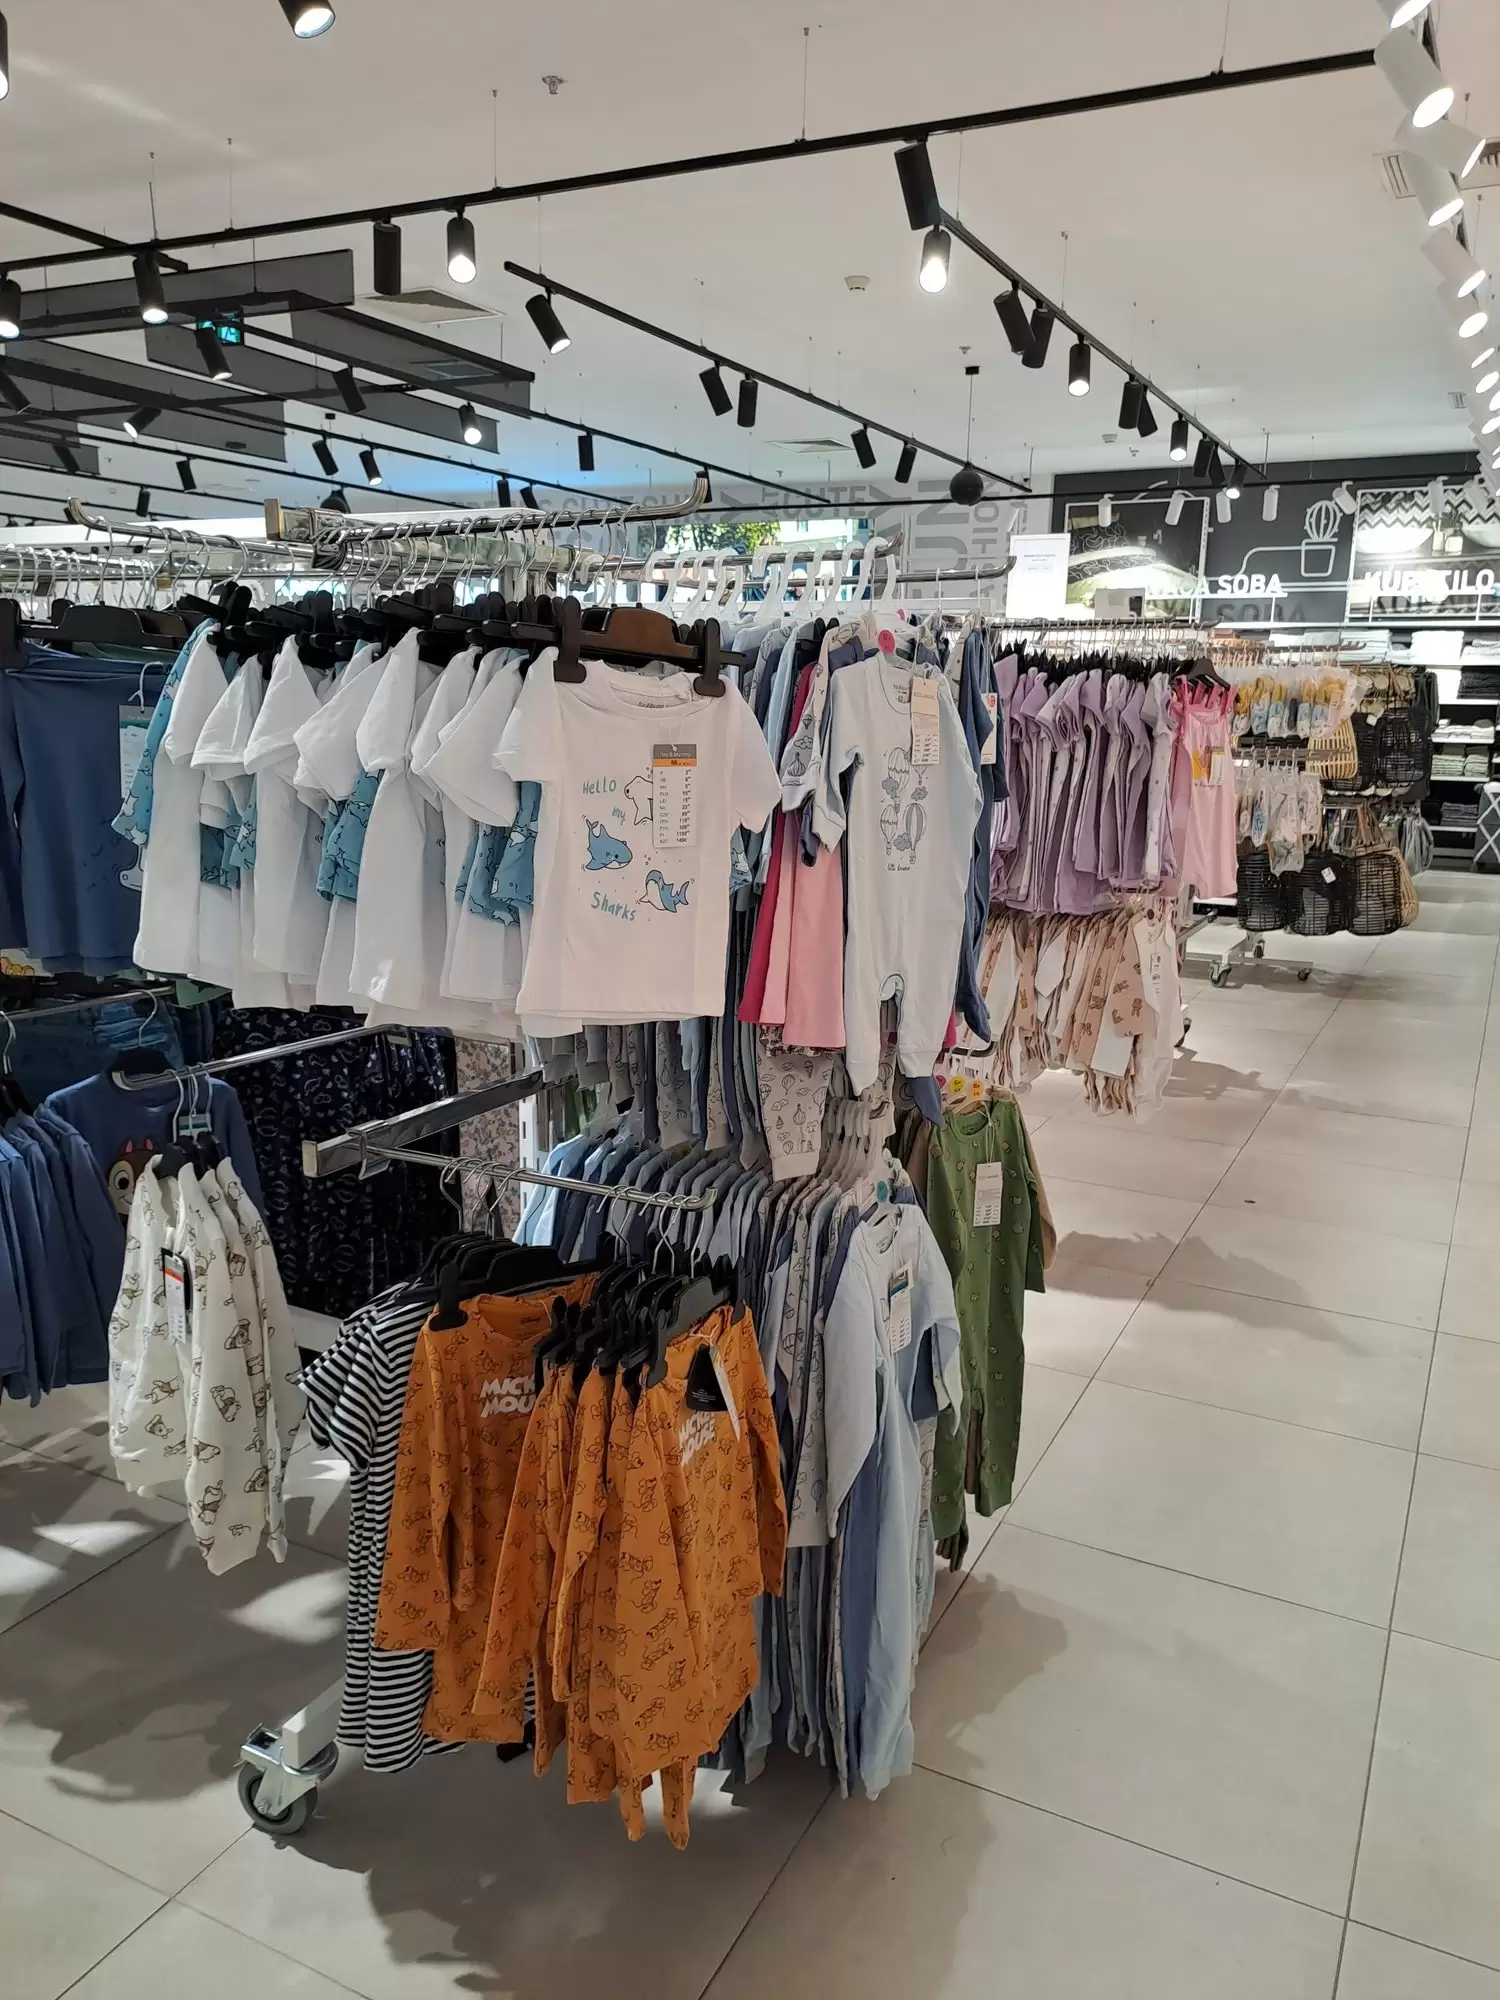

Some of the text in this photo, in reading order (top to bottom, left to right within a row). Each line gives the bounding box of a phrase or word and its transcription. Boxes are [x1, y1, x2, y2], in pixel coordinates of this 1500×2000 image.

[782, 485, 866, 519] CUTE
[1217, 573, 1283, 595] SOBA
[611, 806, 627, 826] my
[590, 891, 637, 922] Sharks
[480, 1375, 536, 1398] MICK
[480, 1394, 536, 1419] MOU
